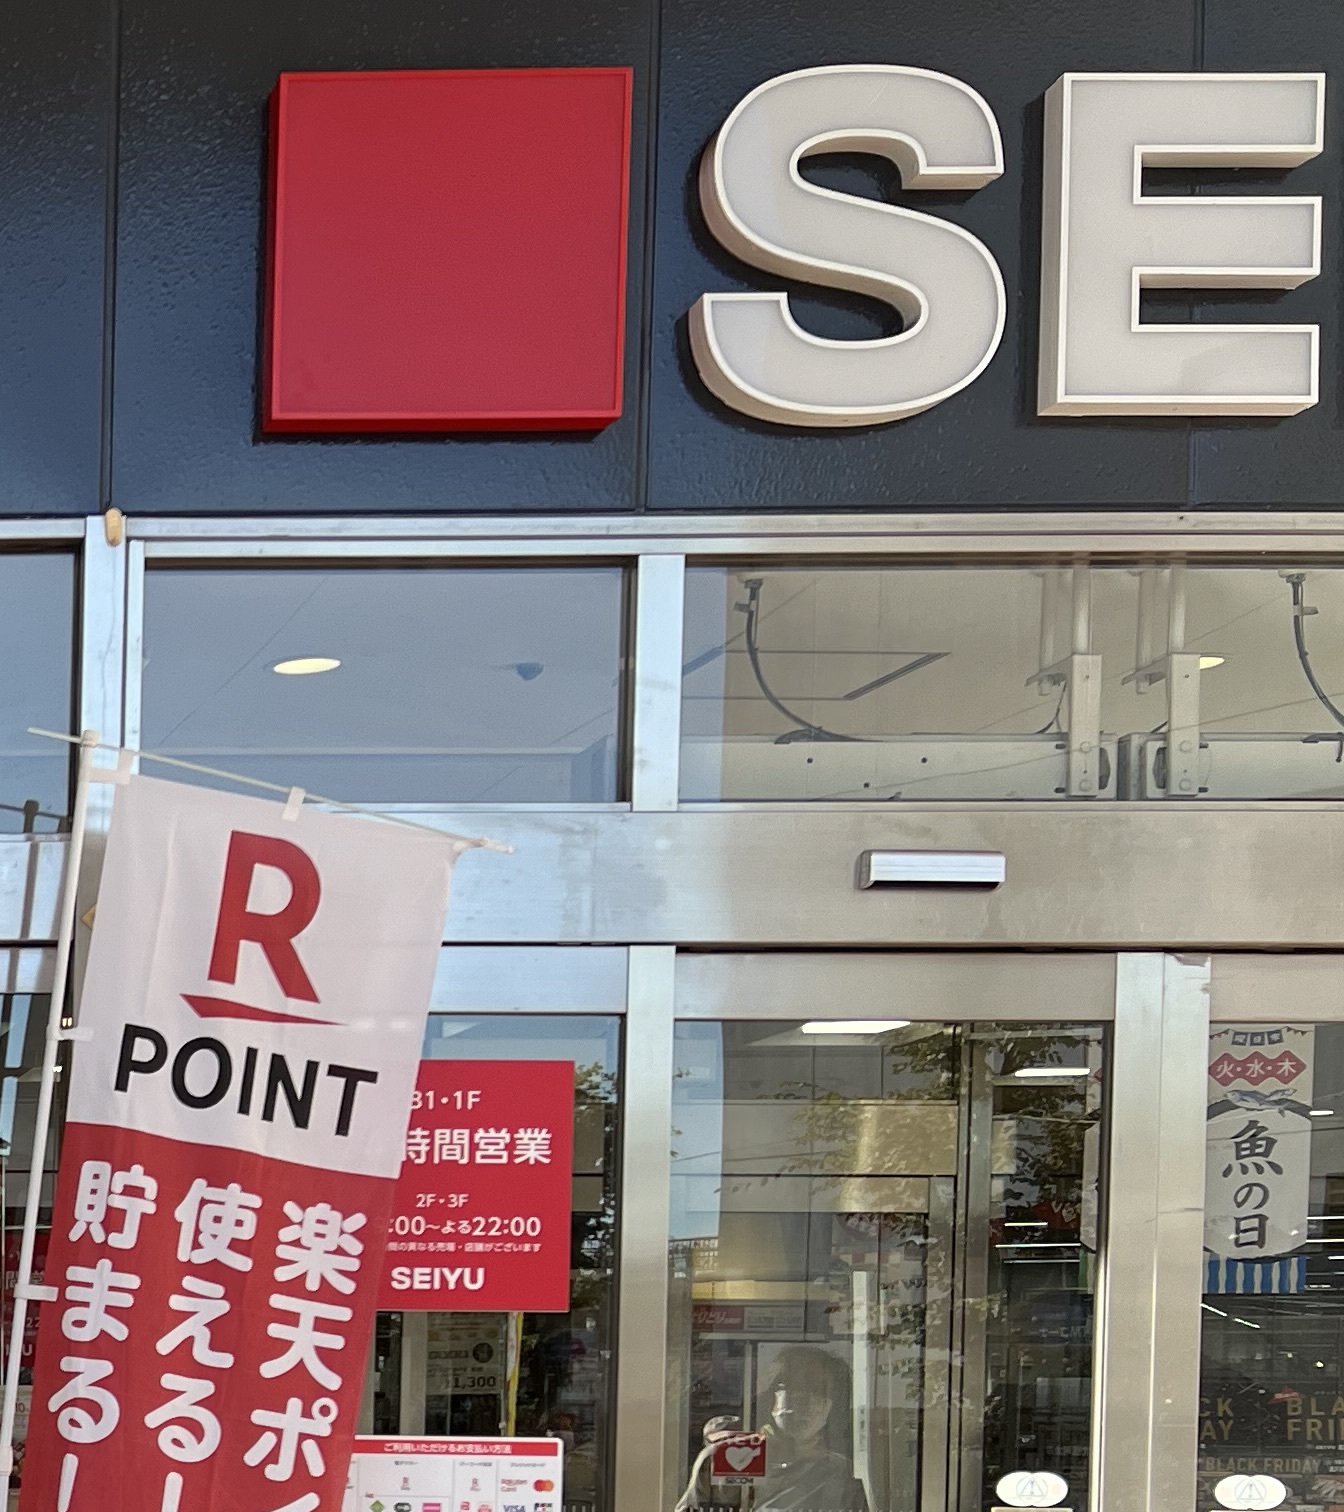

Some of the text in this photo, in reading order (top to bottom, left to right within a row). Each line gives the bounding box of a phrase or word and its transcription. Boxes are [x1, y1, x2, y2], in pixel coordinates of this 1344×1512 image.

[689, 63, 1326, 428] SE
[207, 829, 321, 1004] R
[113, 1023, 378, 1137] POINT
[1215, 1057, 1297, 1079] 火・水・木
[1222, 1119, 1284, 1250] 魚の日
[389, 1266, 486, 1291] SEIYU
[1285, 1418, 1344, 1441] FRI
[1205, 1457, 1257, 1472] BLACK
[1262, 1457, 1322, 1474] FRIDAY
